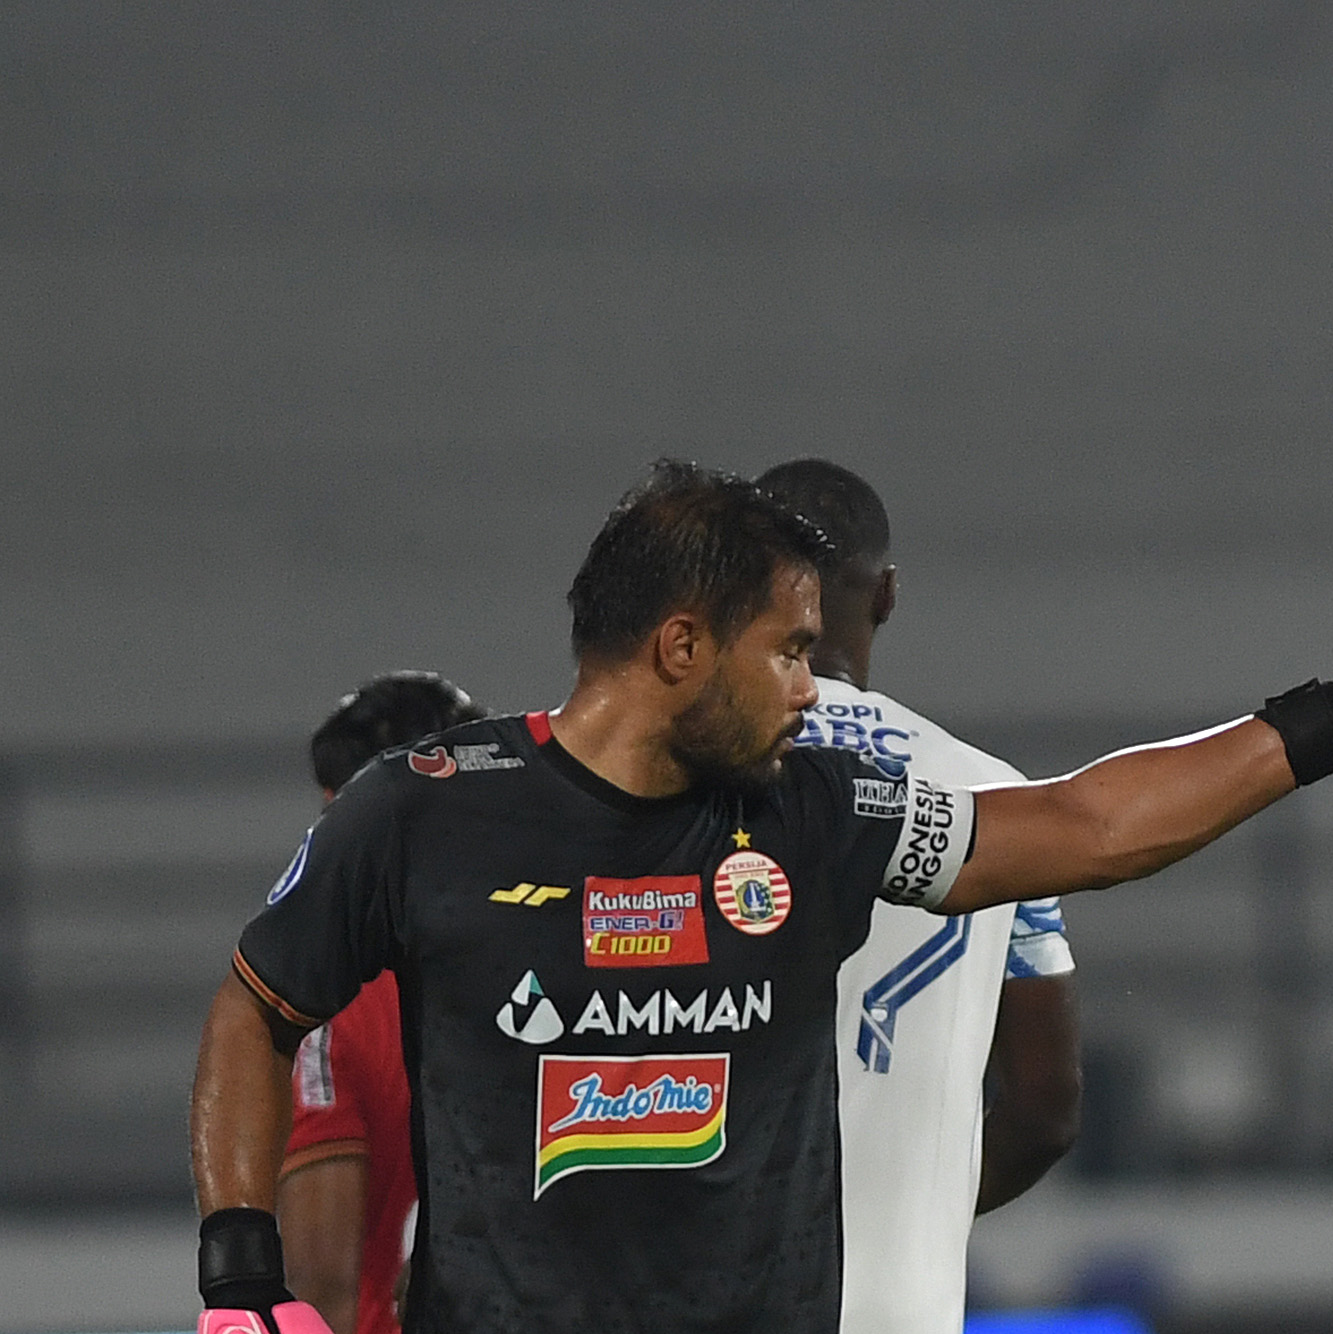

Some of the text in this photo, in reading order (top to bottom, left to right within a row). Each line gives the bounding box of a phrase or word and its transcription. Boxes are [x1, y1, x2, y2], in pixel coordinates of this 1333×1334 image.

[793, 718, 913, 763] ABC
[589, 891, 697, 911] KukuBima
[590, 932, 671, 955] C1000
[572, 980, 772, 1036] AMMAN
